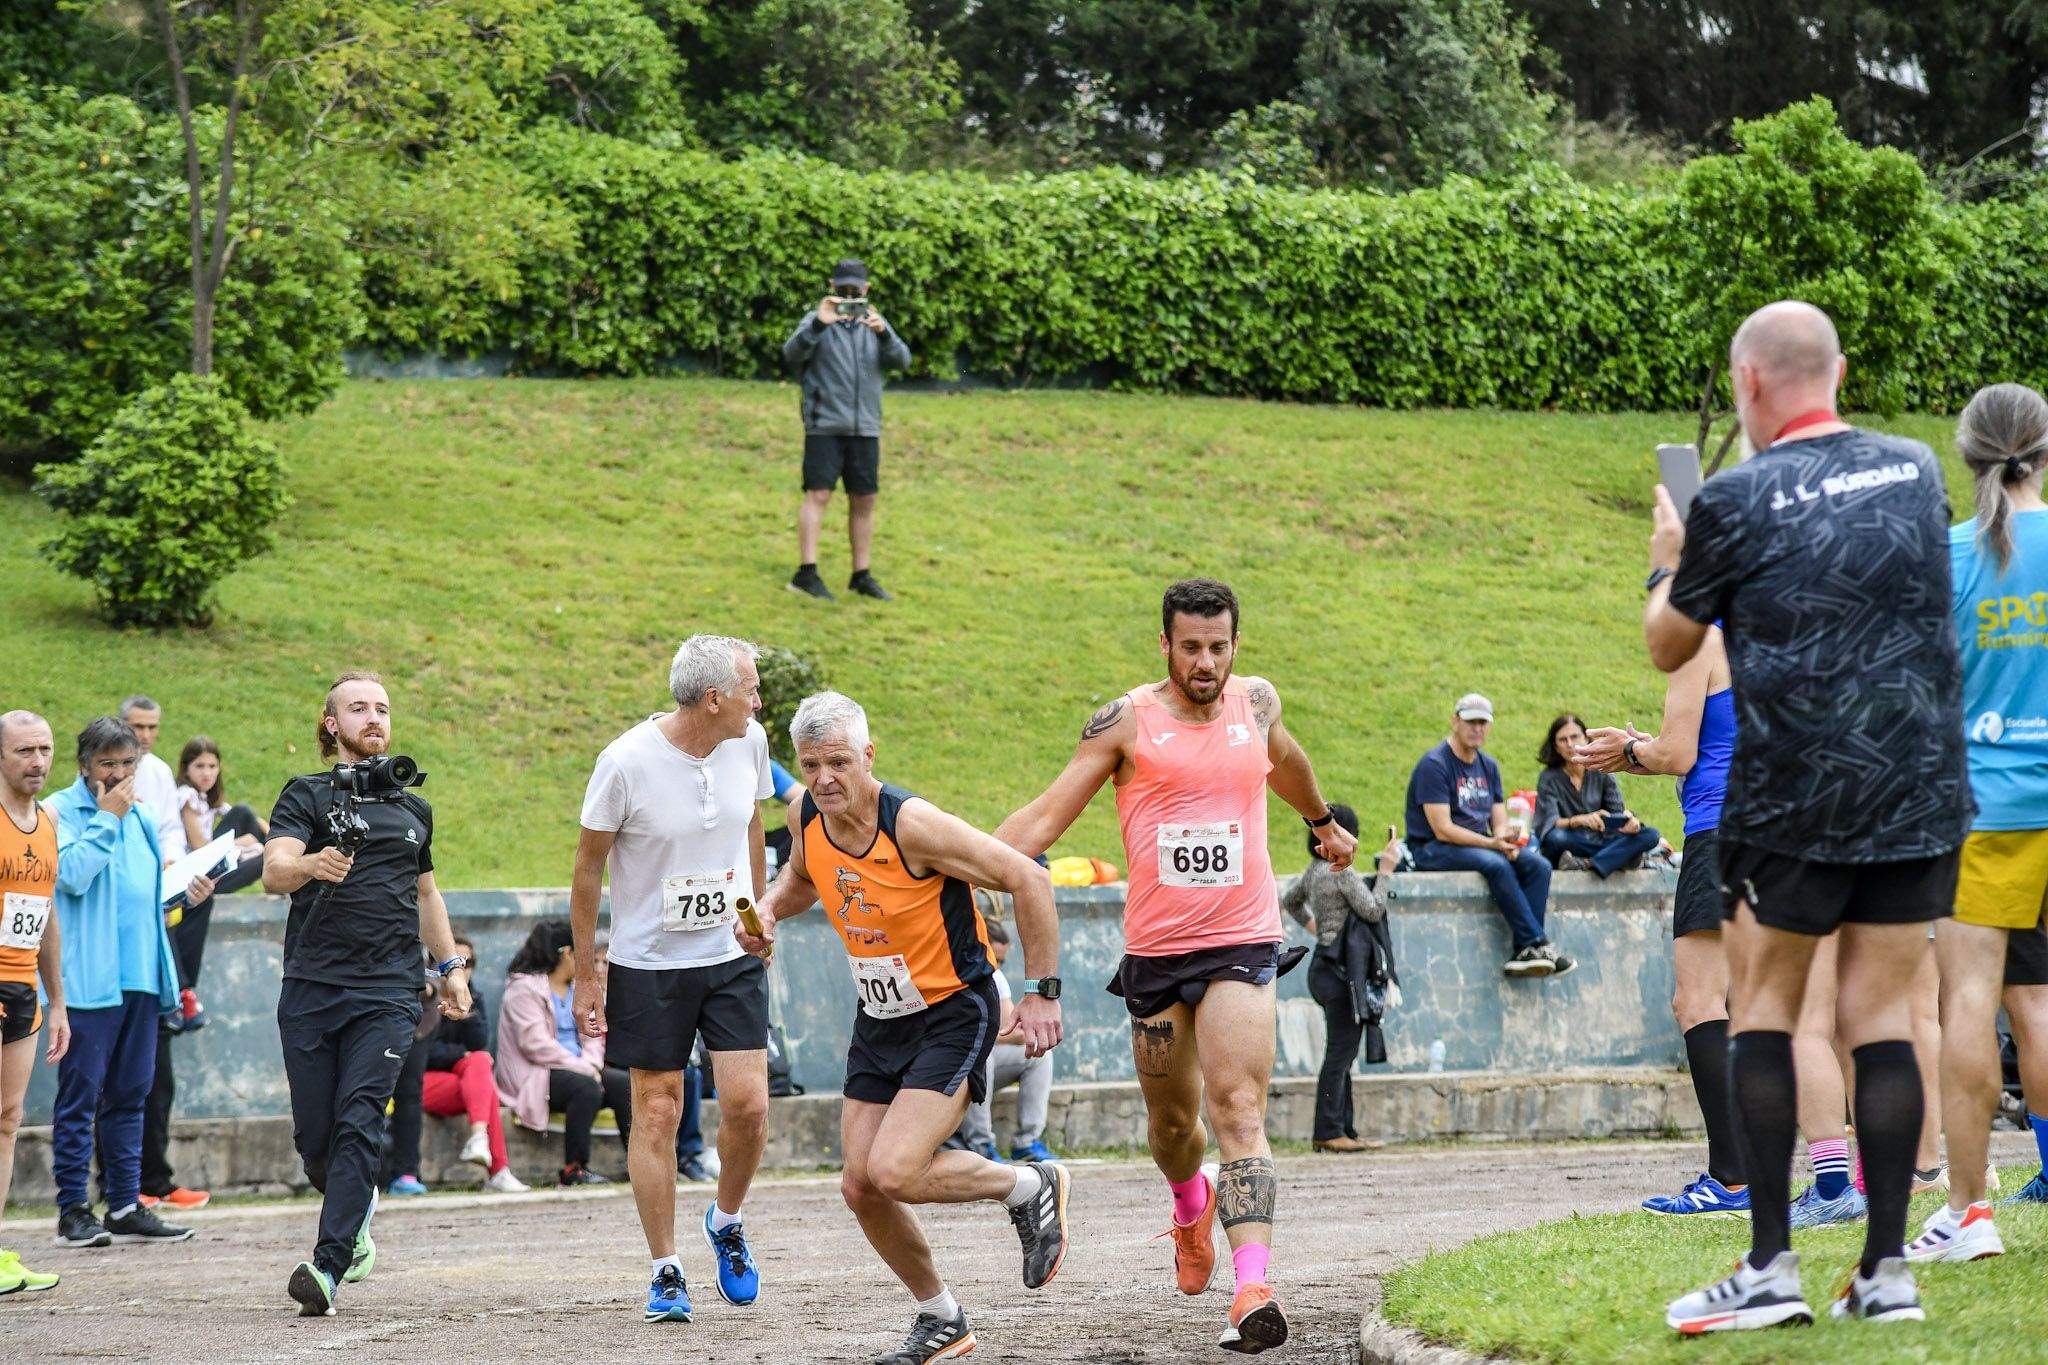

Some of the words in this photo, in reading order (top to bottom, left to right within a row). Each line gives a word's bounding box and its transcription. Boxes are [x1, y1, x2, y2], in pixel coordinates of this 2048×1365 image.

[1173, 845, 1229, 873] 698
[1224, 874, 1240, 883] 2023
[678, 891, 727, 919] 783
[720, 915, 734, 923] 2023
[859, 976, 904, 1004] 701
[905, 1001, 922, 1010] 2023
